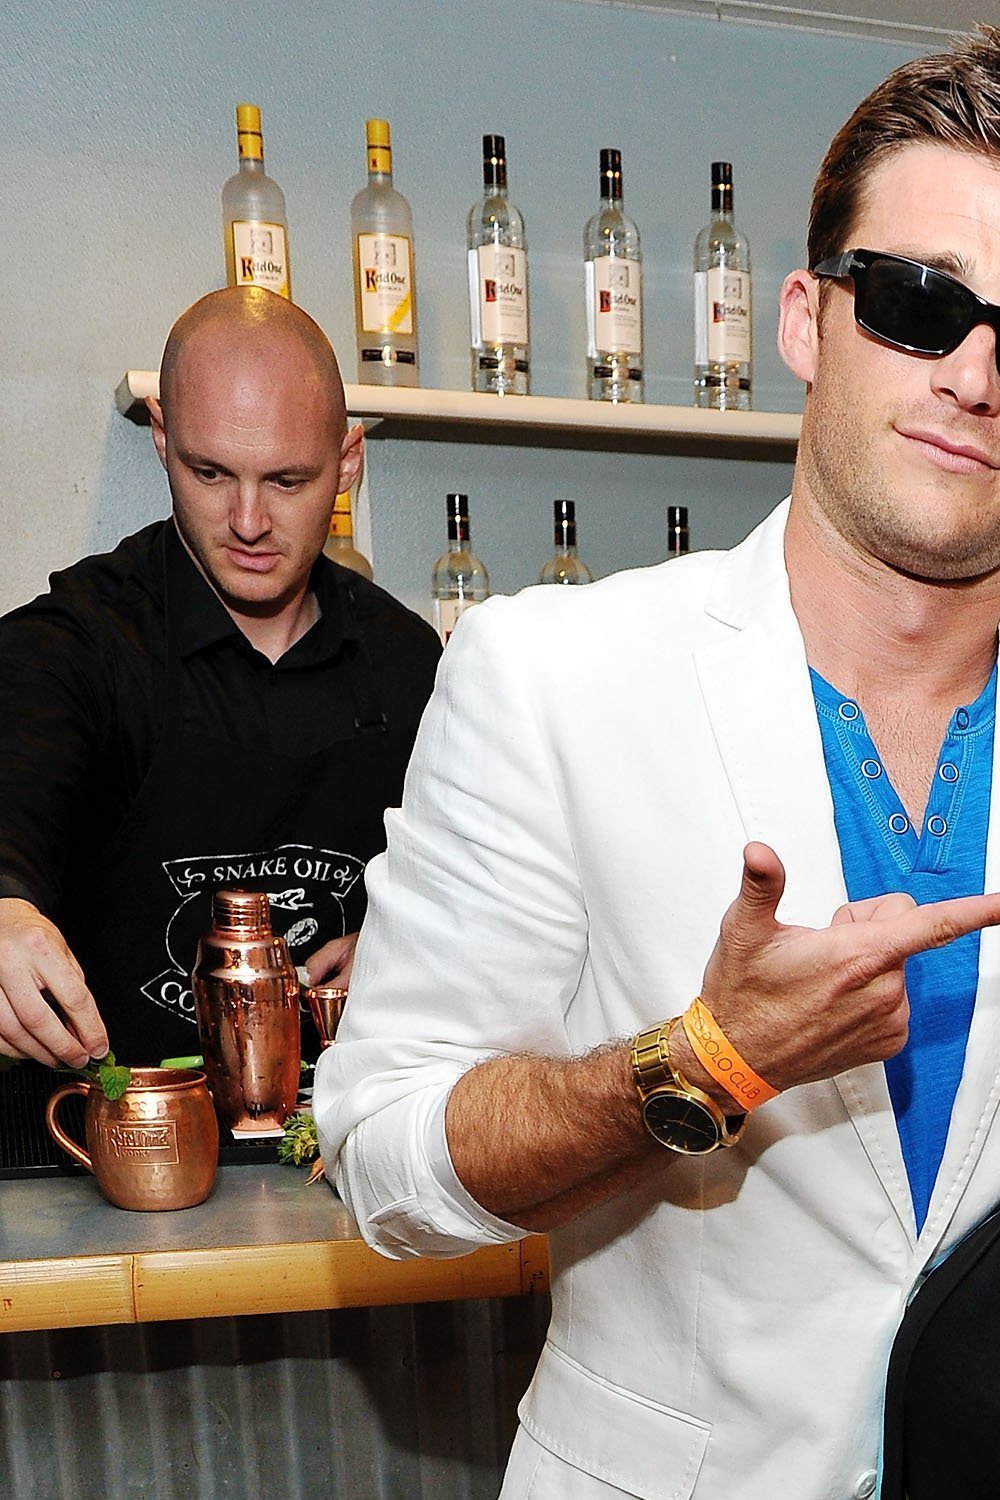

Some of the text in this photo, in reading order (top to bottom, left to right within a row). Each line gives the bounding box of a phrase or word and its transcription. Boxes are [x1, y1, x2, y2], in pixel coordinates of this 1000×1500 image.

[213, 857, 332, 882] SNAKE OIL
[700, 1031, 761, 1100] POLO CLUB
